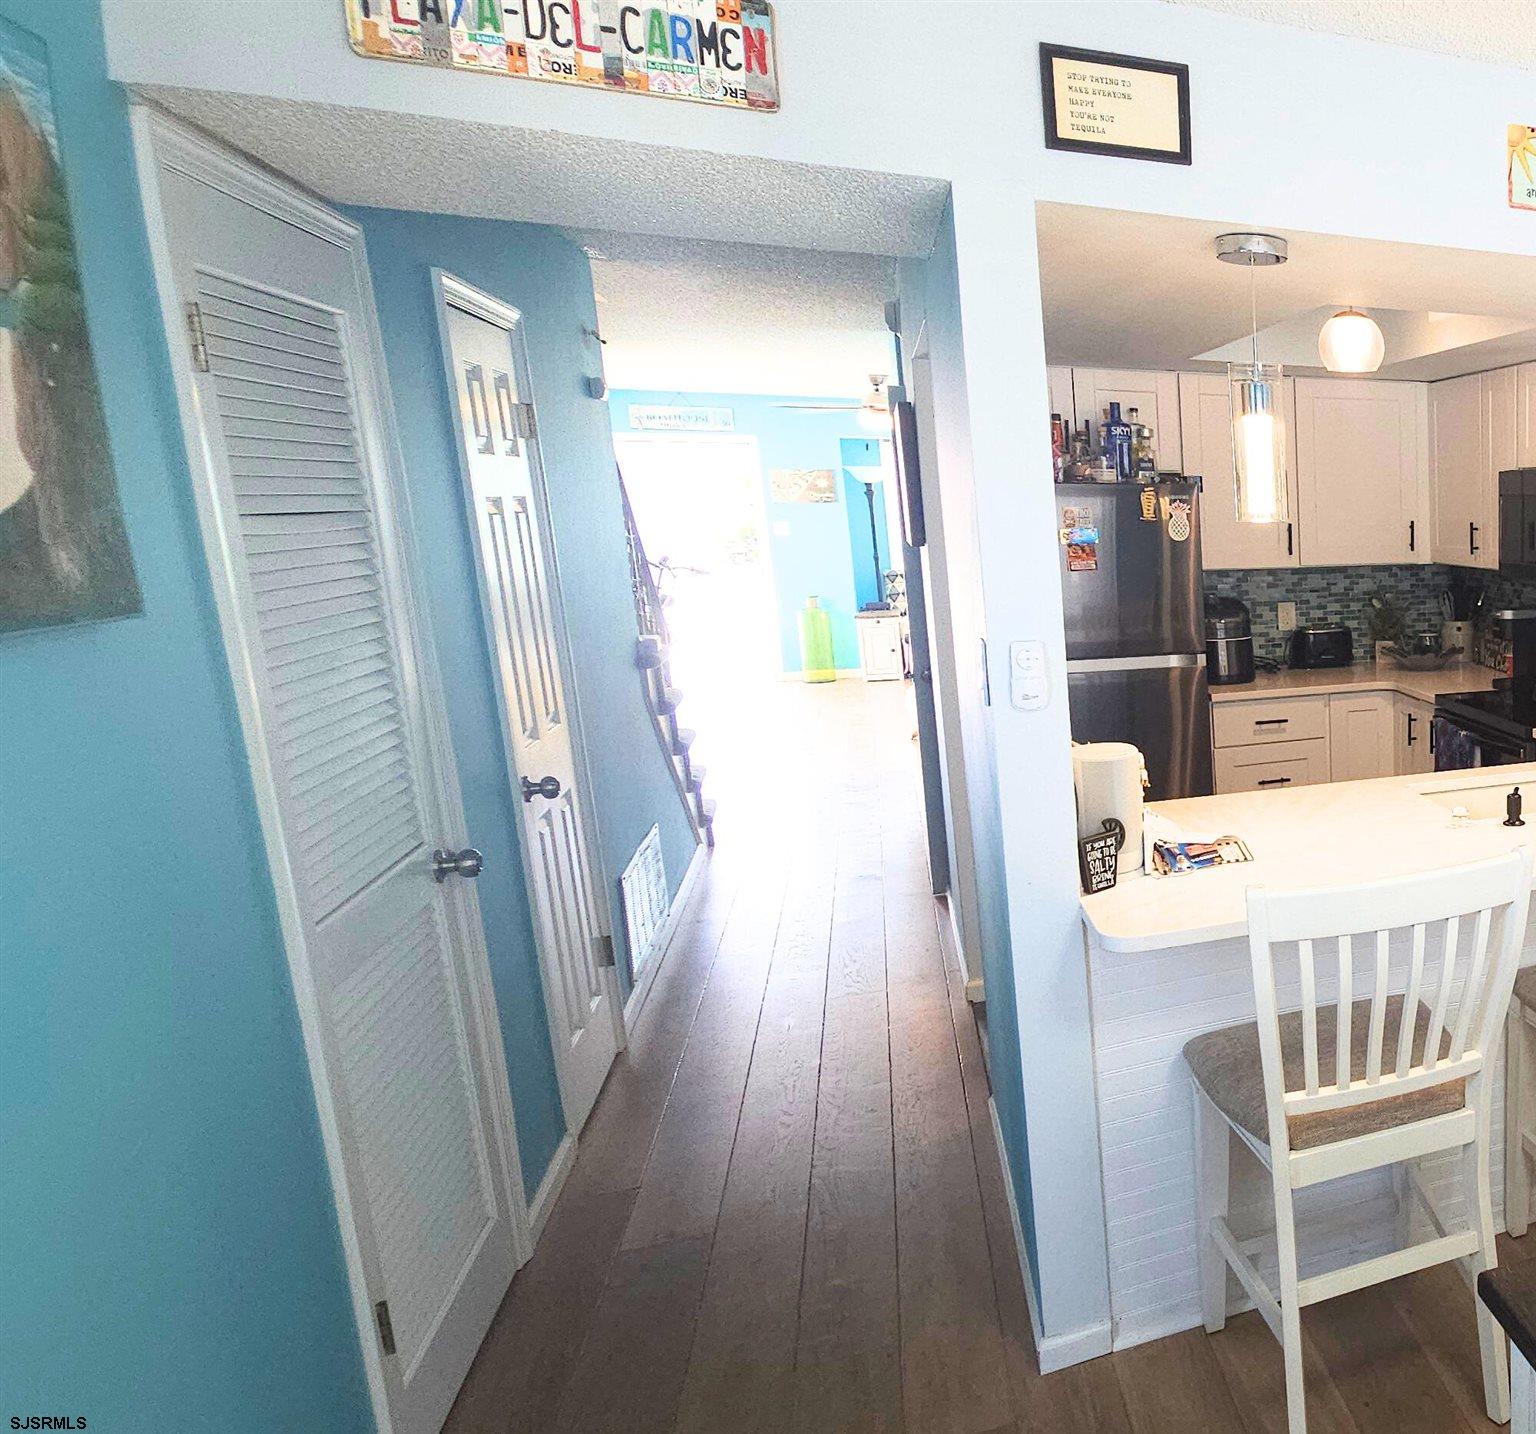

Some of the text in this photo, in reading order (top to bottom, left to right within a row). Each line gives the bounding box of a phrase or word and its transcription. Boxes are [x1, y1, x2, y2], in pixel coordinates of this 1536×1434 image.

[1067, 72, 1132, 88] STOP TRYING TO
[1068, 85, 1132, 100] MAKE EVERYONE
[1069, 98, 1095, 108] HAPPY
[1100, 114, 1115, 123] NOT
[1071, 124, 1106, 135] TEQUILA
[1090, 856, 1115, 875] SALTY
